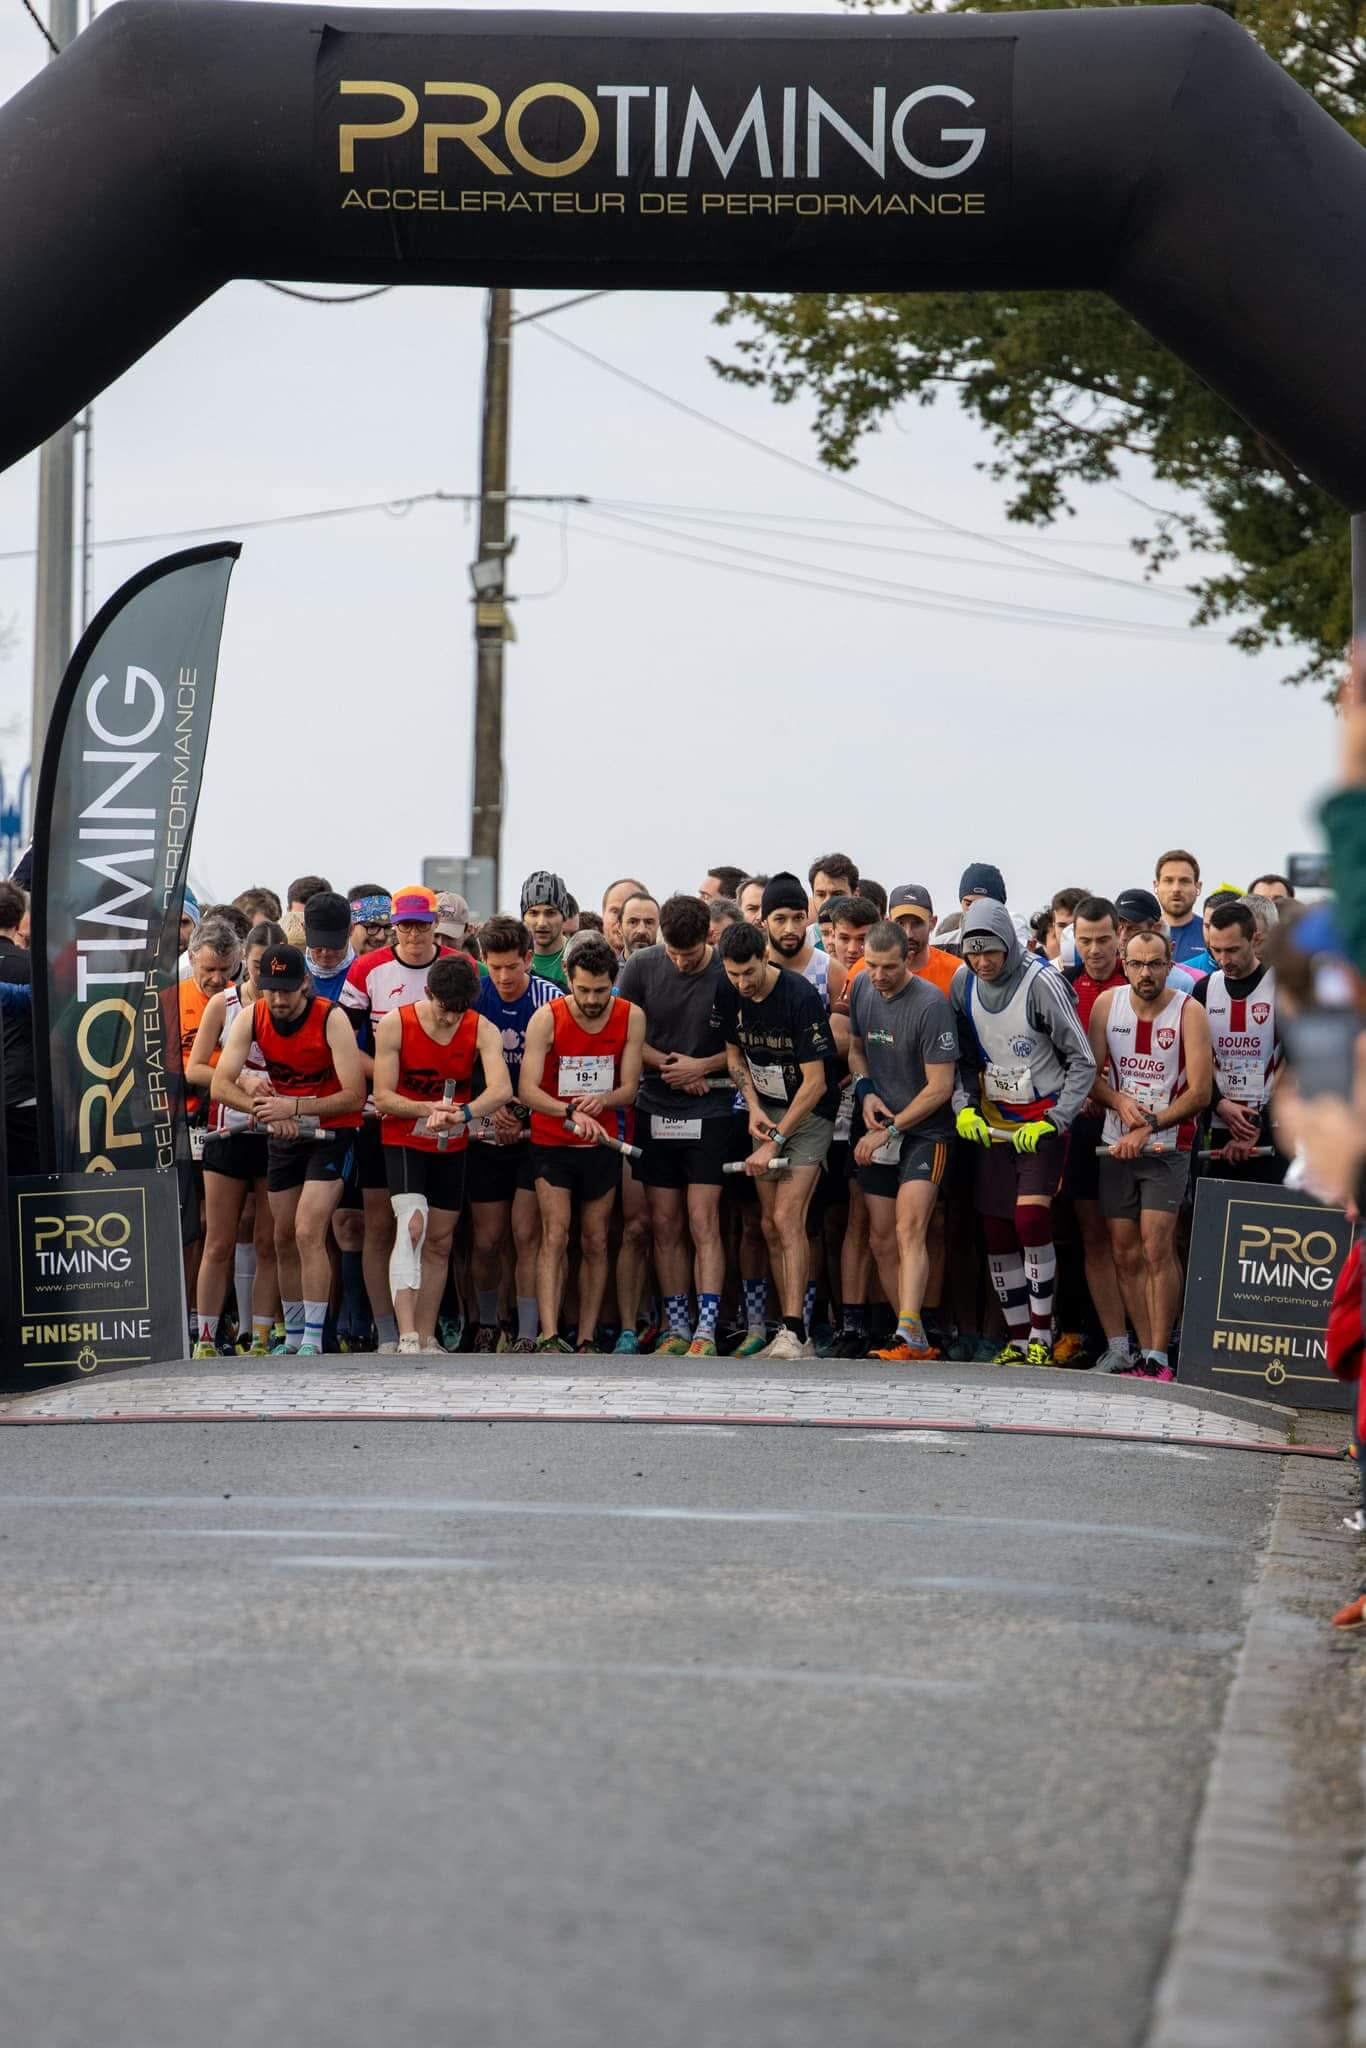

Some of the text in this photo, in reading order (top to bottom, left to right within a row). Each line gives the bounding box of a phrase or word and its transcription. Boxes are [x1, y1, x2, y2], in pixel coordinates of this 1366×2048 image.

[339, 80, 987, 180] PROTIMING
[340, 188, 986, 216] ACCELERATEUR DE PERFORMANCE
[1218, 1036, 1261, 1049] BOURG
[1230, 1049, 1261, 1057] GIRONDE
[576, 1071, 598, 1082] 19-1
[1119, 1056, 1165, 1073] BOURG
[994, 1079, 1019, 1092] 152-1
[1228, 1075, 1247, 1086] 78-1
[34, 1211, 131, 1251] PRO
[1238, 1224, 1337, 1266] PRO
[35, 1247, 132, 1276] TIMING
[35, 1279, 135, 1293] www.protiming.fr
[1238, 1259, 1334, 1291] TIMING
[21, 1319, 152, 1345] FINISHLINE
[1212, 1329, 1329, 1360] FINISHLIN
